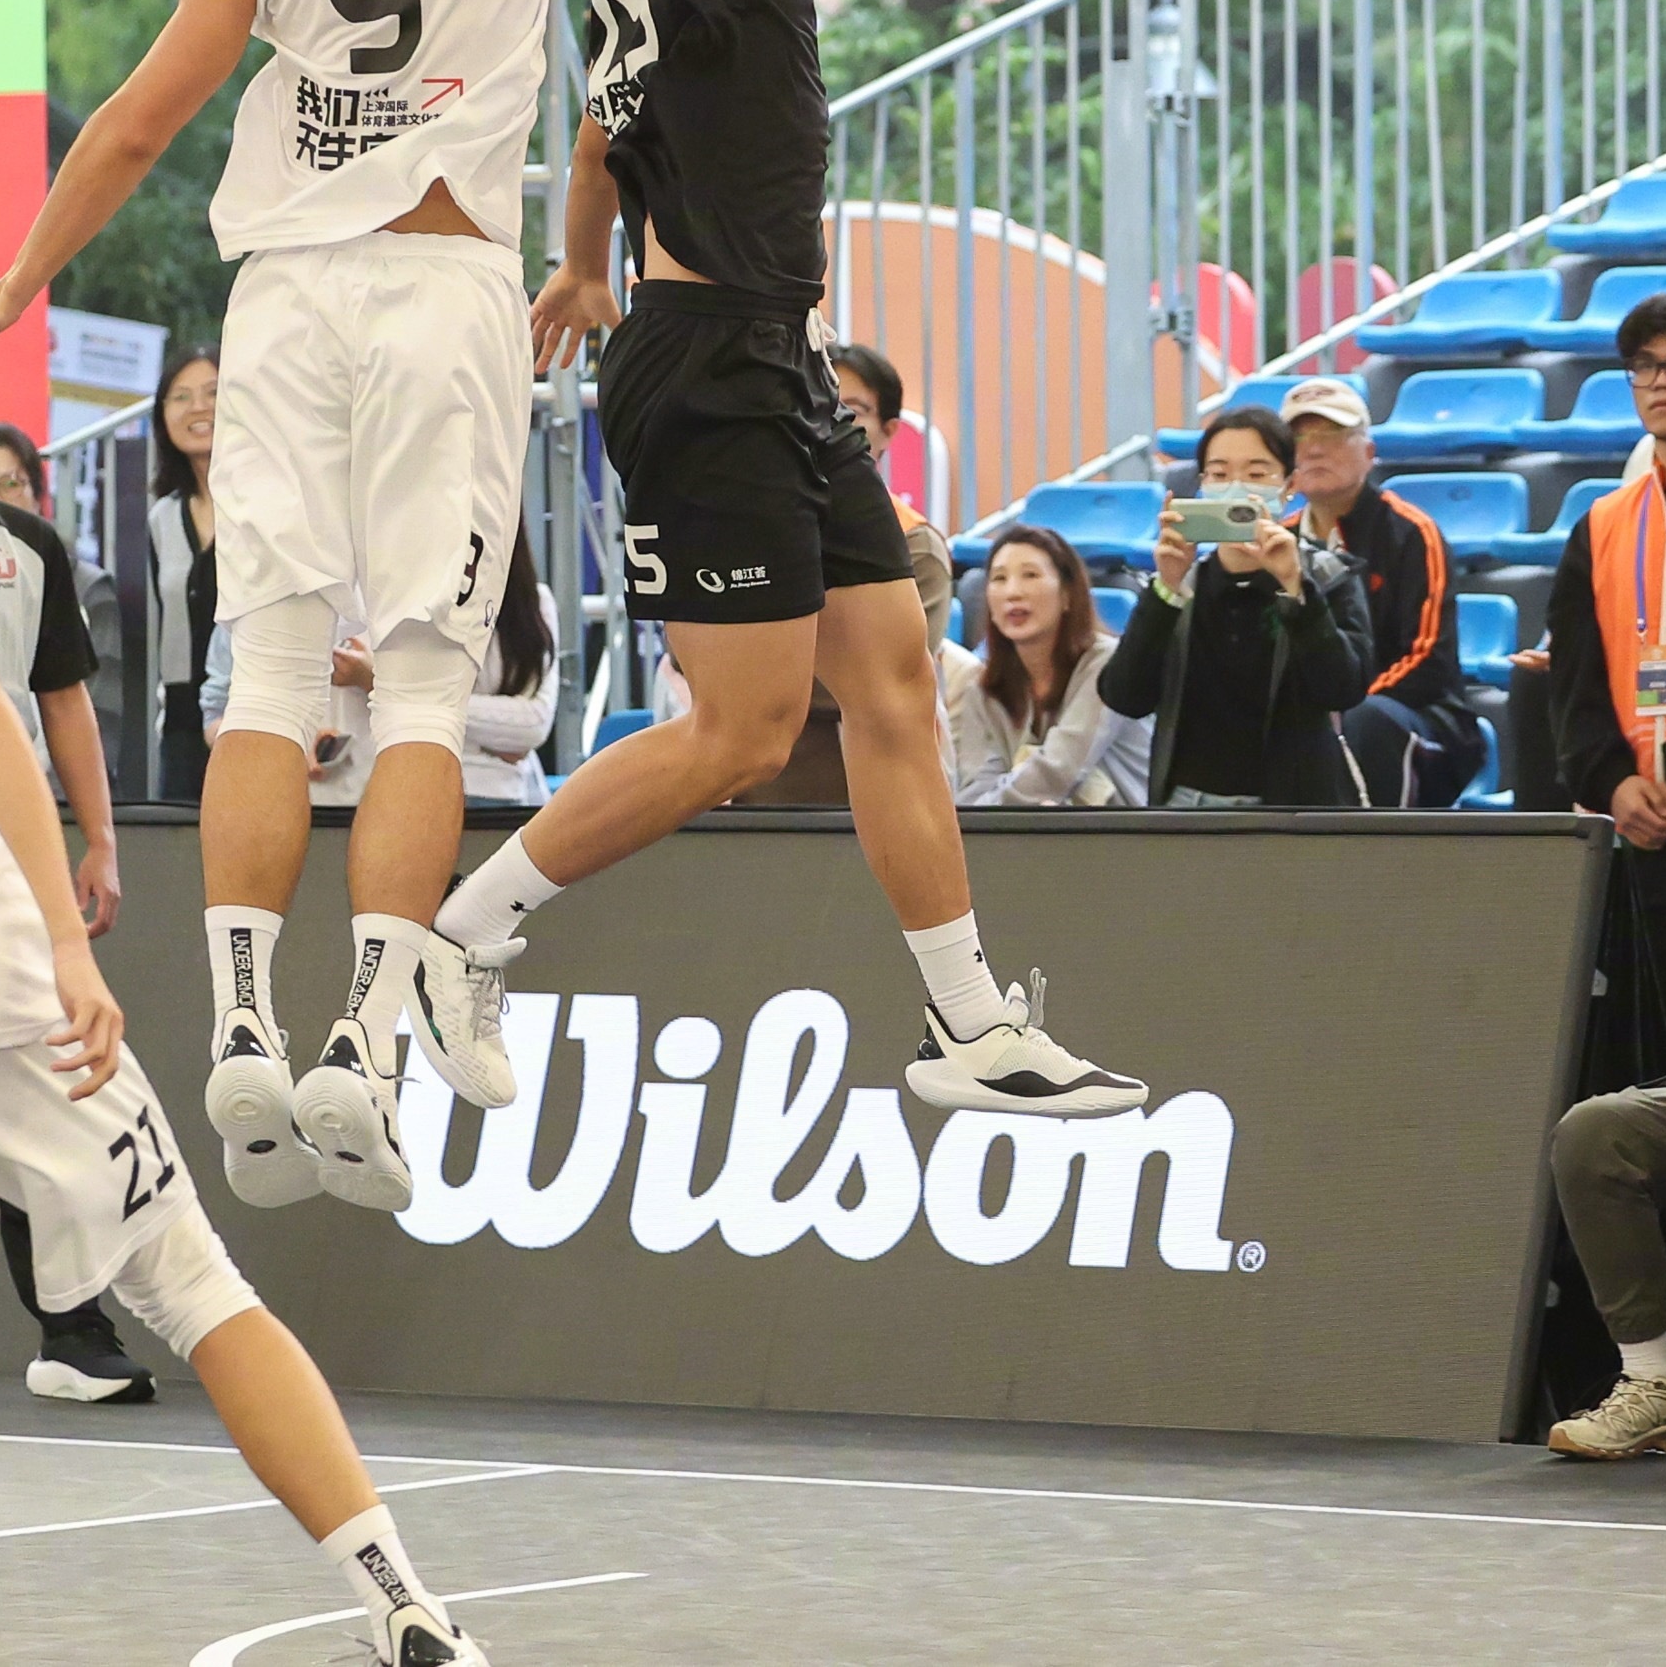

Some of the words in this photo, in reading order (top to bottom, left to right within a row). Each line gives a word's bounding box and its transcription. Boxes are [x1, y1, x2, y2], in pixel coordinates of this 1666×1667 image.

[296, 74, 361, 127] 我们
[362, 100, 409, 113] 上海国际
[108, 1103, 176, 1223] 21
[361, 1547, 413, 1608] UNDERAR
